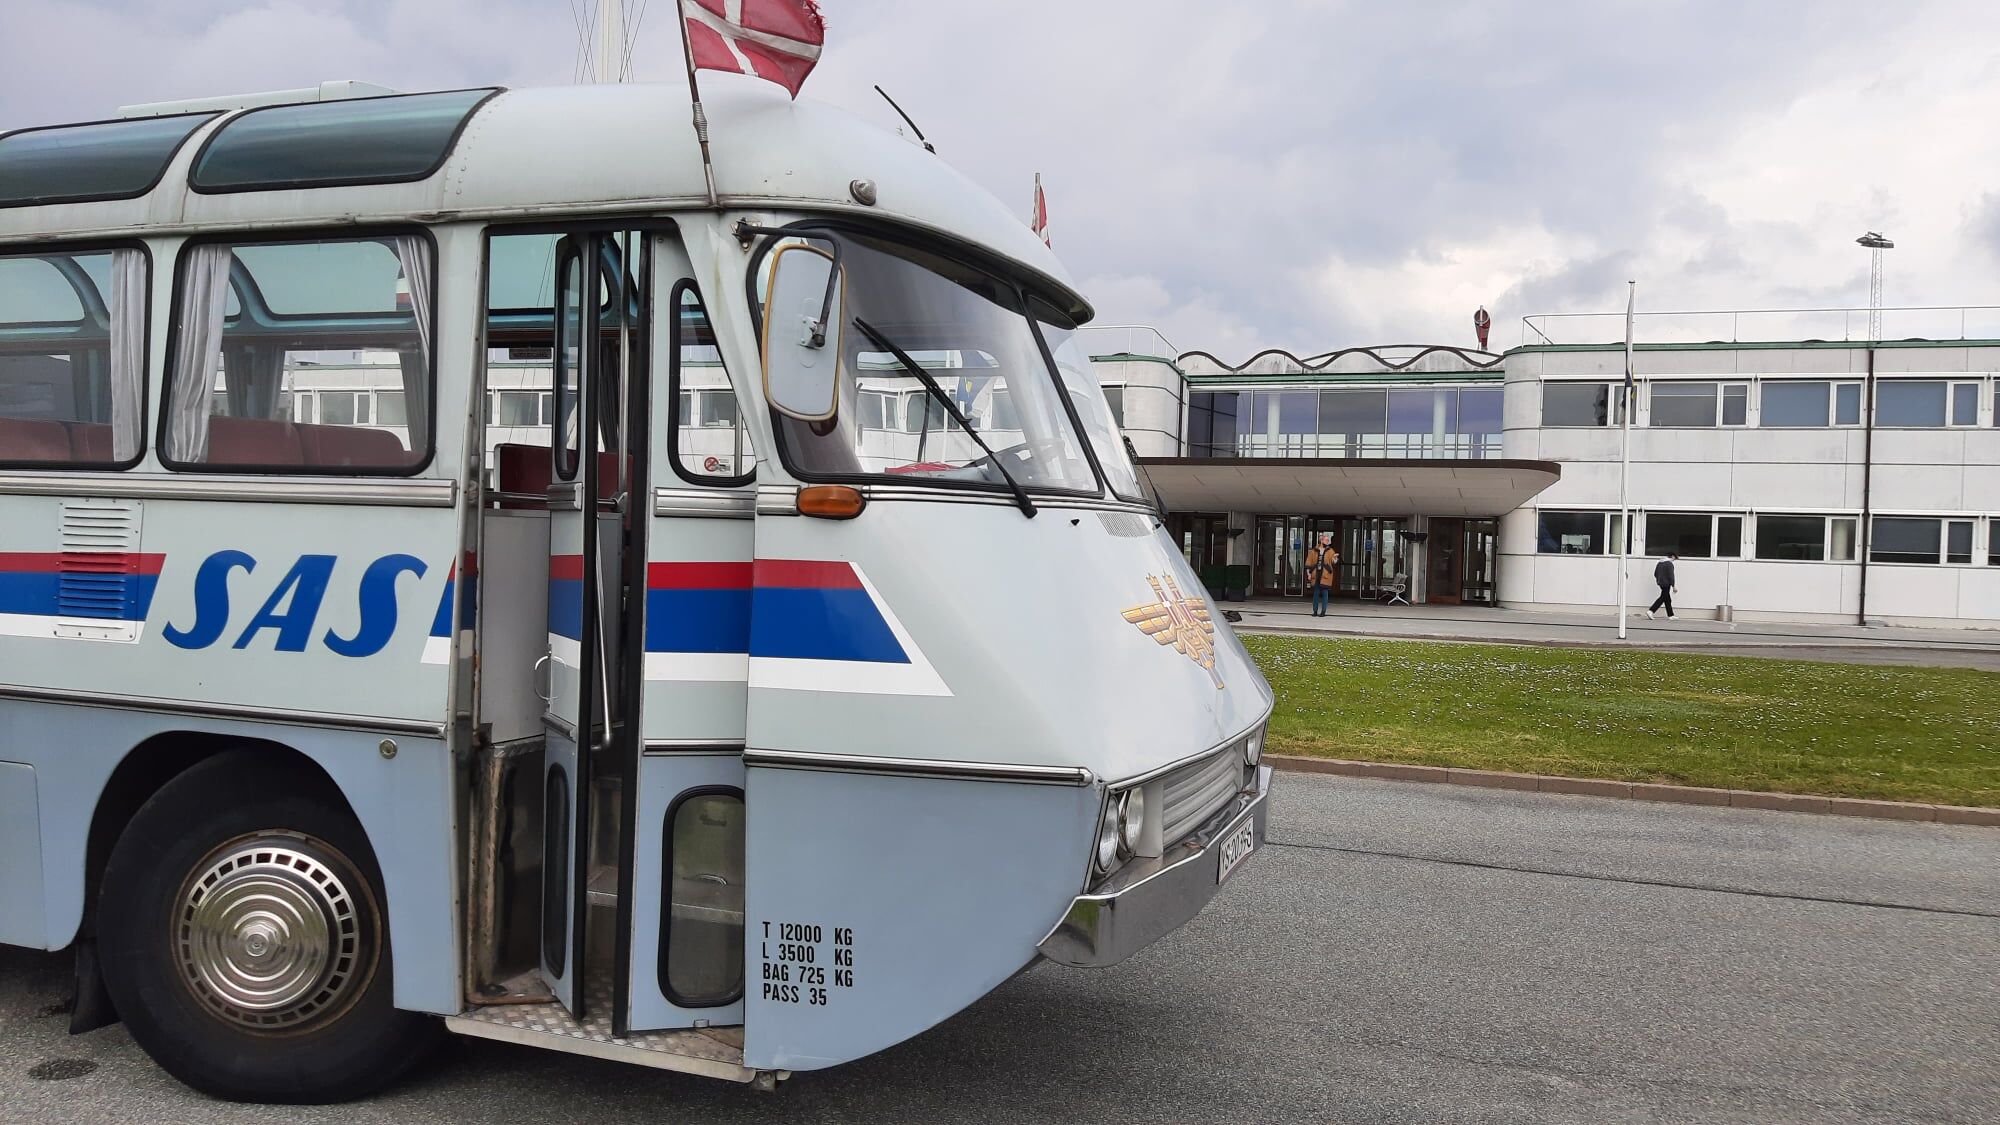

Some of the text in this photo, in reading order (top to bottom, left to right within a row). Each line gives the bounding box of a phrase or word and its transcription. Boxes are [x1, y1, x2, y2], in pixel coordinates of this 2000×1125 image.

[161, 549, 429, 658] SAS
[762, 921, 853, 946] T 12000 KG
[762, 941, 853, 967] L 3500 KG
[762, 962, 853, 988] BAG 725 KG
[763, 982, 827, 1006] PASS 35
